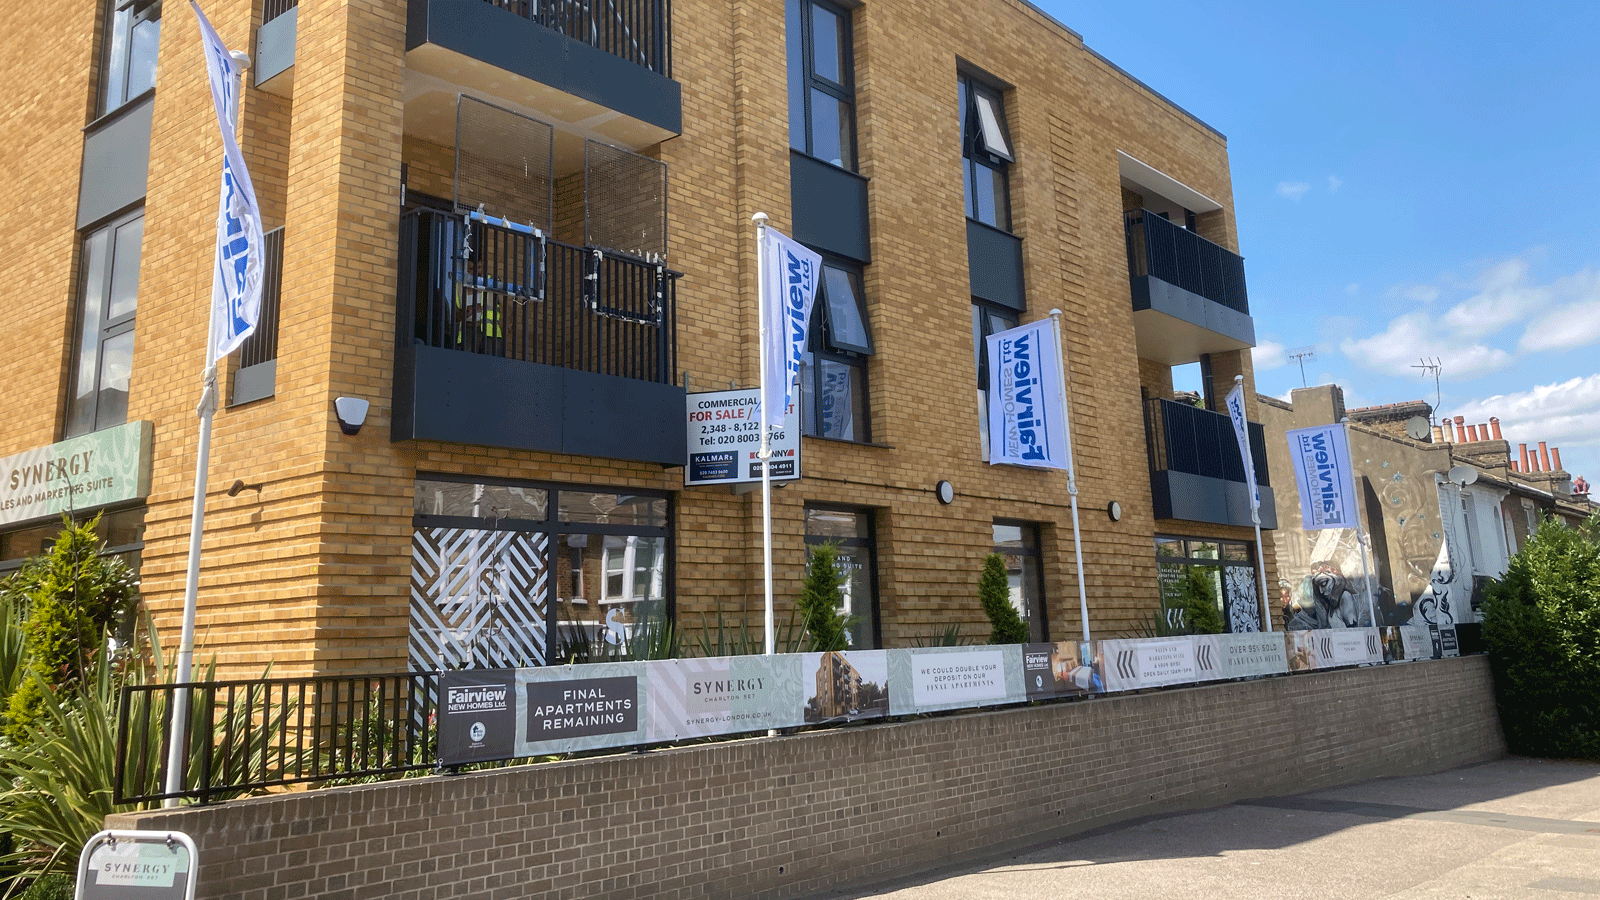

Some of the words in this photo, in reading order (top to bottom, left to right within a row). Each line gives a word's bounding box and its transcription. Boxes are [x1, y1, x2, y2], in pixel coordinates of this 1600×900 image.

[698, 397, 758, 409] COMMERCIAL
[689, 411, 713, 422] FOR
[716, 408, 744, 420] SALE
[701, 424, 726, 434] 2,348
[734, 422, 759, 432] 8,122
[699, 437, 715, 446] Tel:
[718, 435, 735, 444] 020
[737, 433, 760, 443] 8003
[768, 431, 785, 441] 766
[10, 450, 93, 490] SYNERGY
[16, 495, 33, 507] AND
[87, 477, 113, 492] SUITE
[1229, 645, 1246, 654] OVER
[1262, 643, 1277, 652] SOLD
[932, 666, 953, 674] COULD
[934, 674, 961, 682] DEPOSIT
[694, 677, 765, 695] SYNERGY
[448, 687, 506, 703] Fairview
[564, 688, 606, 700] FINAL
[467, 702, 493, 710] HOMES
[534, 699, 632, 717] APARTMENTS
[543, 713, 625, 730] REMAINING
[104, 863, 171, 874] SYNERGY
